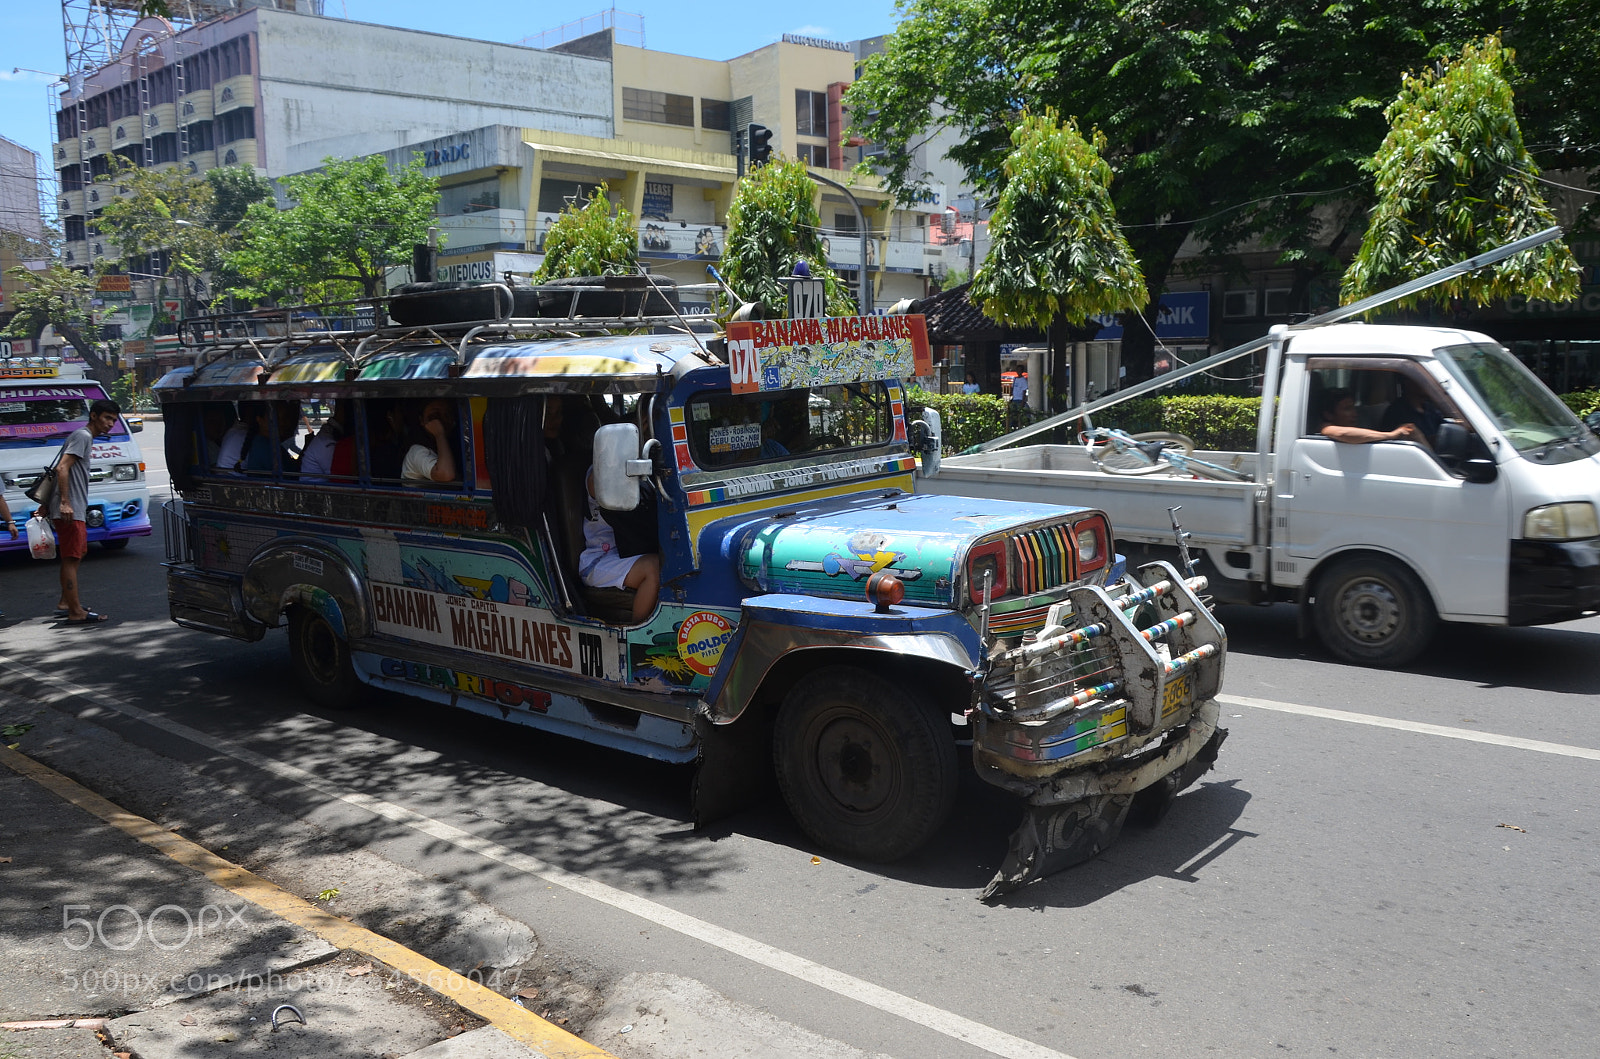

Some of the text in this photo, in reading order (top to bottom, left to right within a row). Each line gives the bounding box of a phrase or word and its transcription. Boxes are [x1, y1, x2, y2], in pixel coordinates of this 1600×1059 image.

[650, 183, 673, 197] LEASE
[449, 261, 491, 283] MEDICUS
[793, 281, 824, 318] 070
[1156, 306, 1195, 325] ANK
[753, 315, 912, 348] BANAWA MAGALLANES
[728, 339, 761, 384] 070
[446, 594, 499, 613] JONES CAPITOL
[374, 585, 441, 634] BANAWA
[450, 606, 573, 669] MAGALLANES
[681, 613, 725, 639] BASTA TUBO
[701, 647, 720, 658] PIPES
[380, 657, 552, 713] CHARIOT
